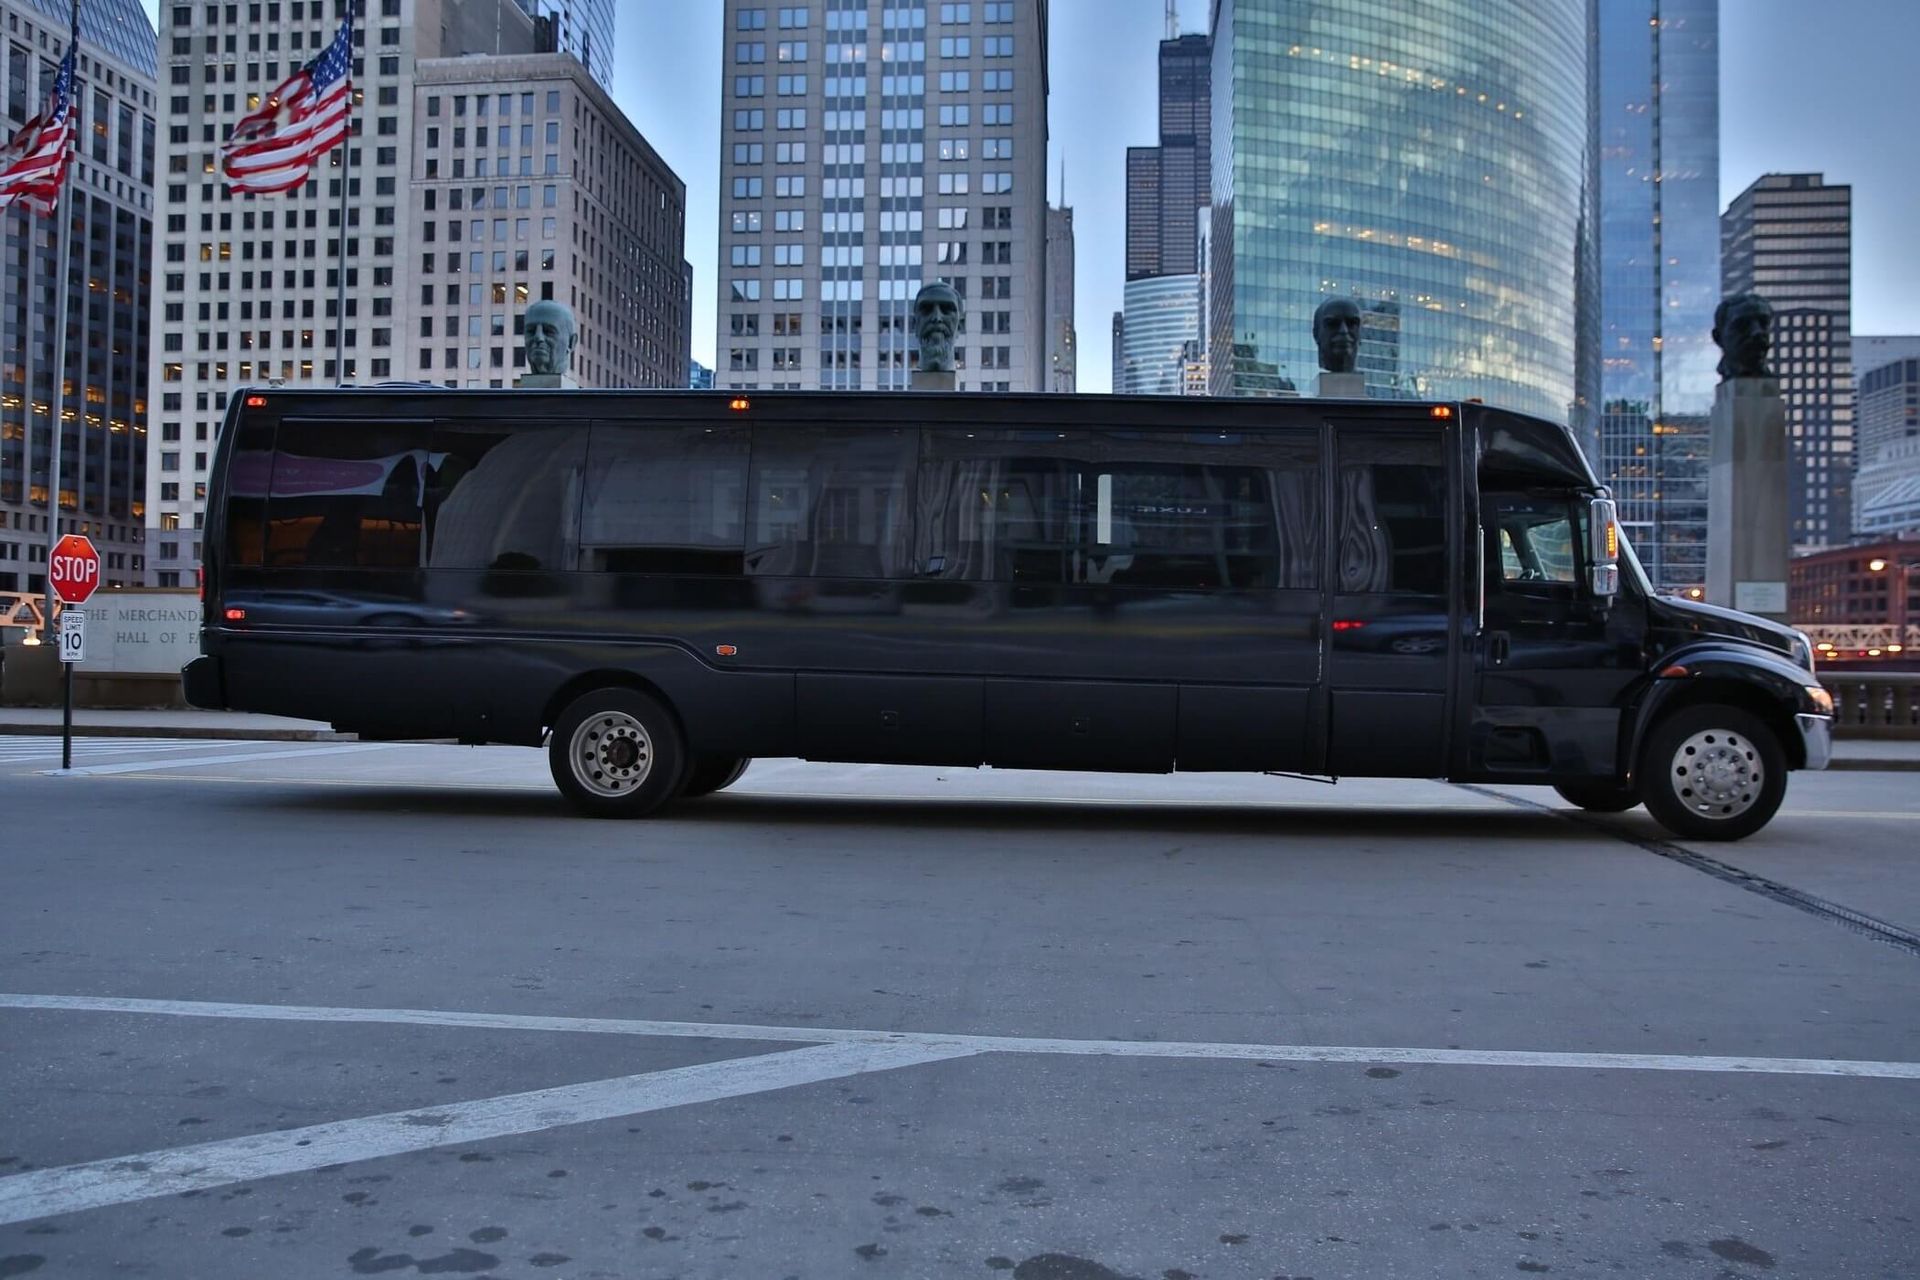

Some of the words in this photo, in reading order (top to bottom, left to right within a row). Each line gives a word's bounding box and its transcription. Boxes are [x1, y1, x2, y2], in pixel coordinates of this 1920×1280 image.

[53, 555, 96, 582] STOP
[63, 615, 84, 624] SPEED
[83, 610, 109, 621] THE
[65, 632, 82, 650] 10
[117, 632, 150, 644] HALL
[159, 632, 177, 644] OF
